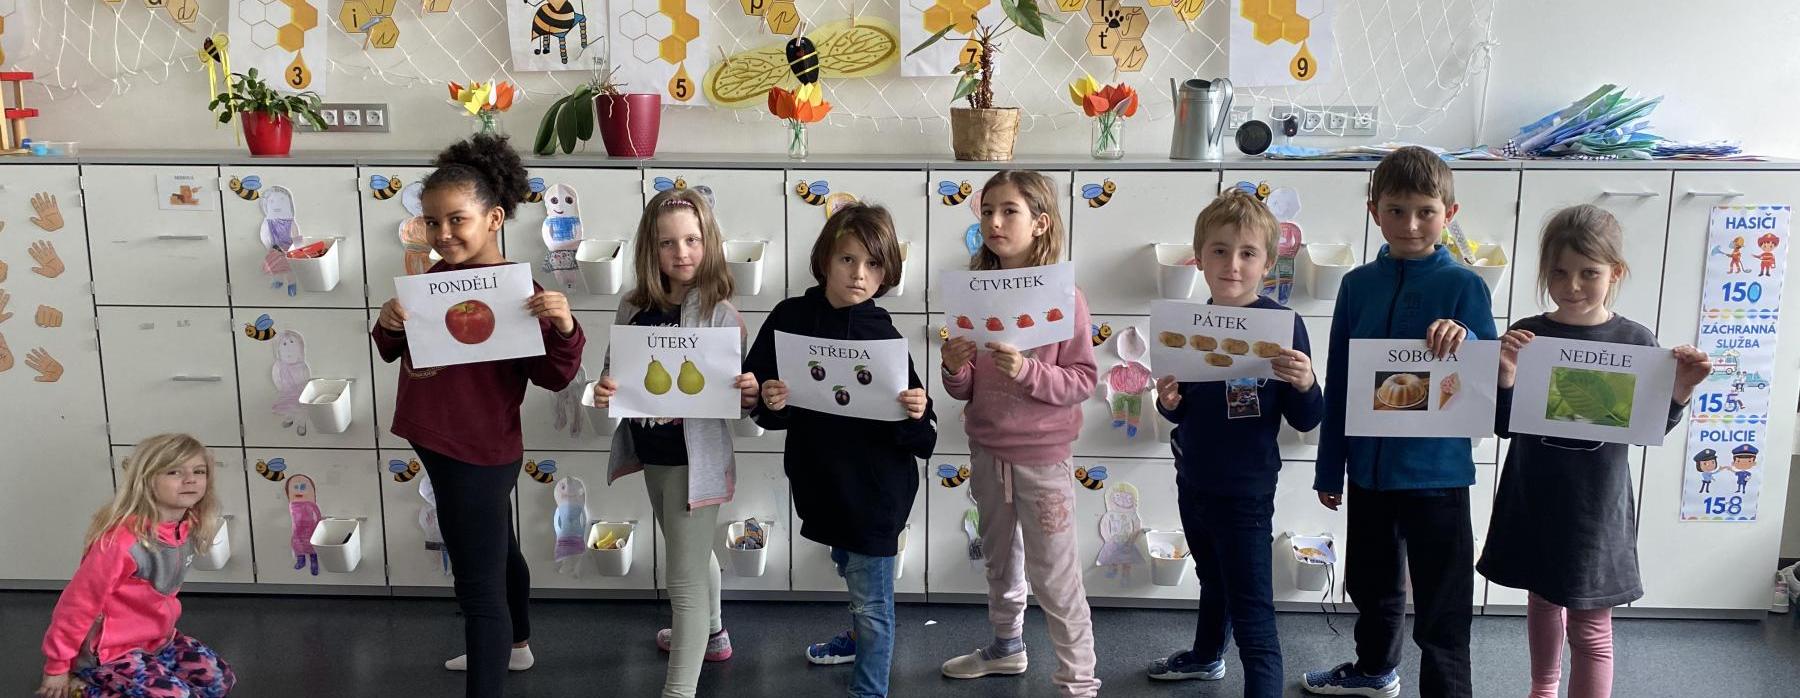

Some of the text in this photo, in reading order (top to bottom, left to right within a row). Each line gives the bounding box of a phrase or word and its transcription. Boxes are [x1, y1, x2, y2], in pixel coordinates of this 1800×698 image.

[351, 8, 358, 28] i
[966, 47, 978, 64] 7
[291, 66, 303, 86] 3
[1296, 57, 1309, 78] 9
[675, 78, 687, 99] 5
[1725, 212, 1777, 230] HASIČI
[429, 272, 498, 295] PONDĚLÍ
[969, 275, 1045, 291] ČTVRTEK
[1721, 281, 1763, 304] 150
[1192, 311, 1248, 331] PÁTEK
[1701, 321, 1777, 335] ZÁCHRANNÁ
[647, 332, 699, 349] ÚTERÝ
[1716, 335, 1760, 349] SLUŽBA
[808, 344, 871, 360] STŘEDA
[1559, 347, 1633, 368] NEDĚLE
[1698, 393, 1738, 413] 155
[1699, 430, 1757, 442] POLICIE
[1703, 495, 1743, 515] 158
